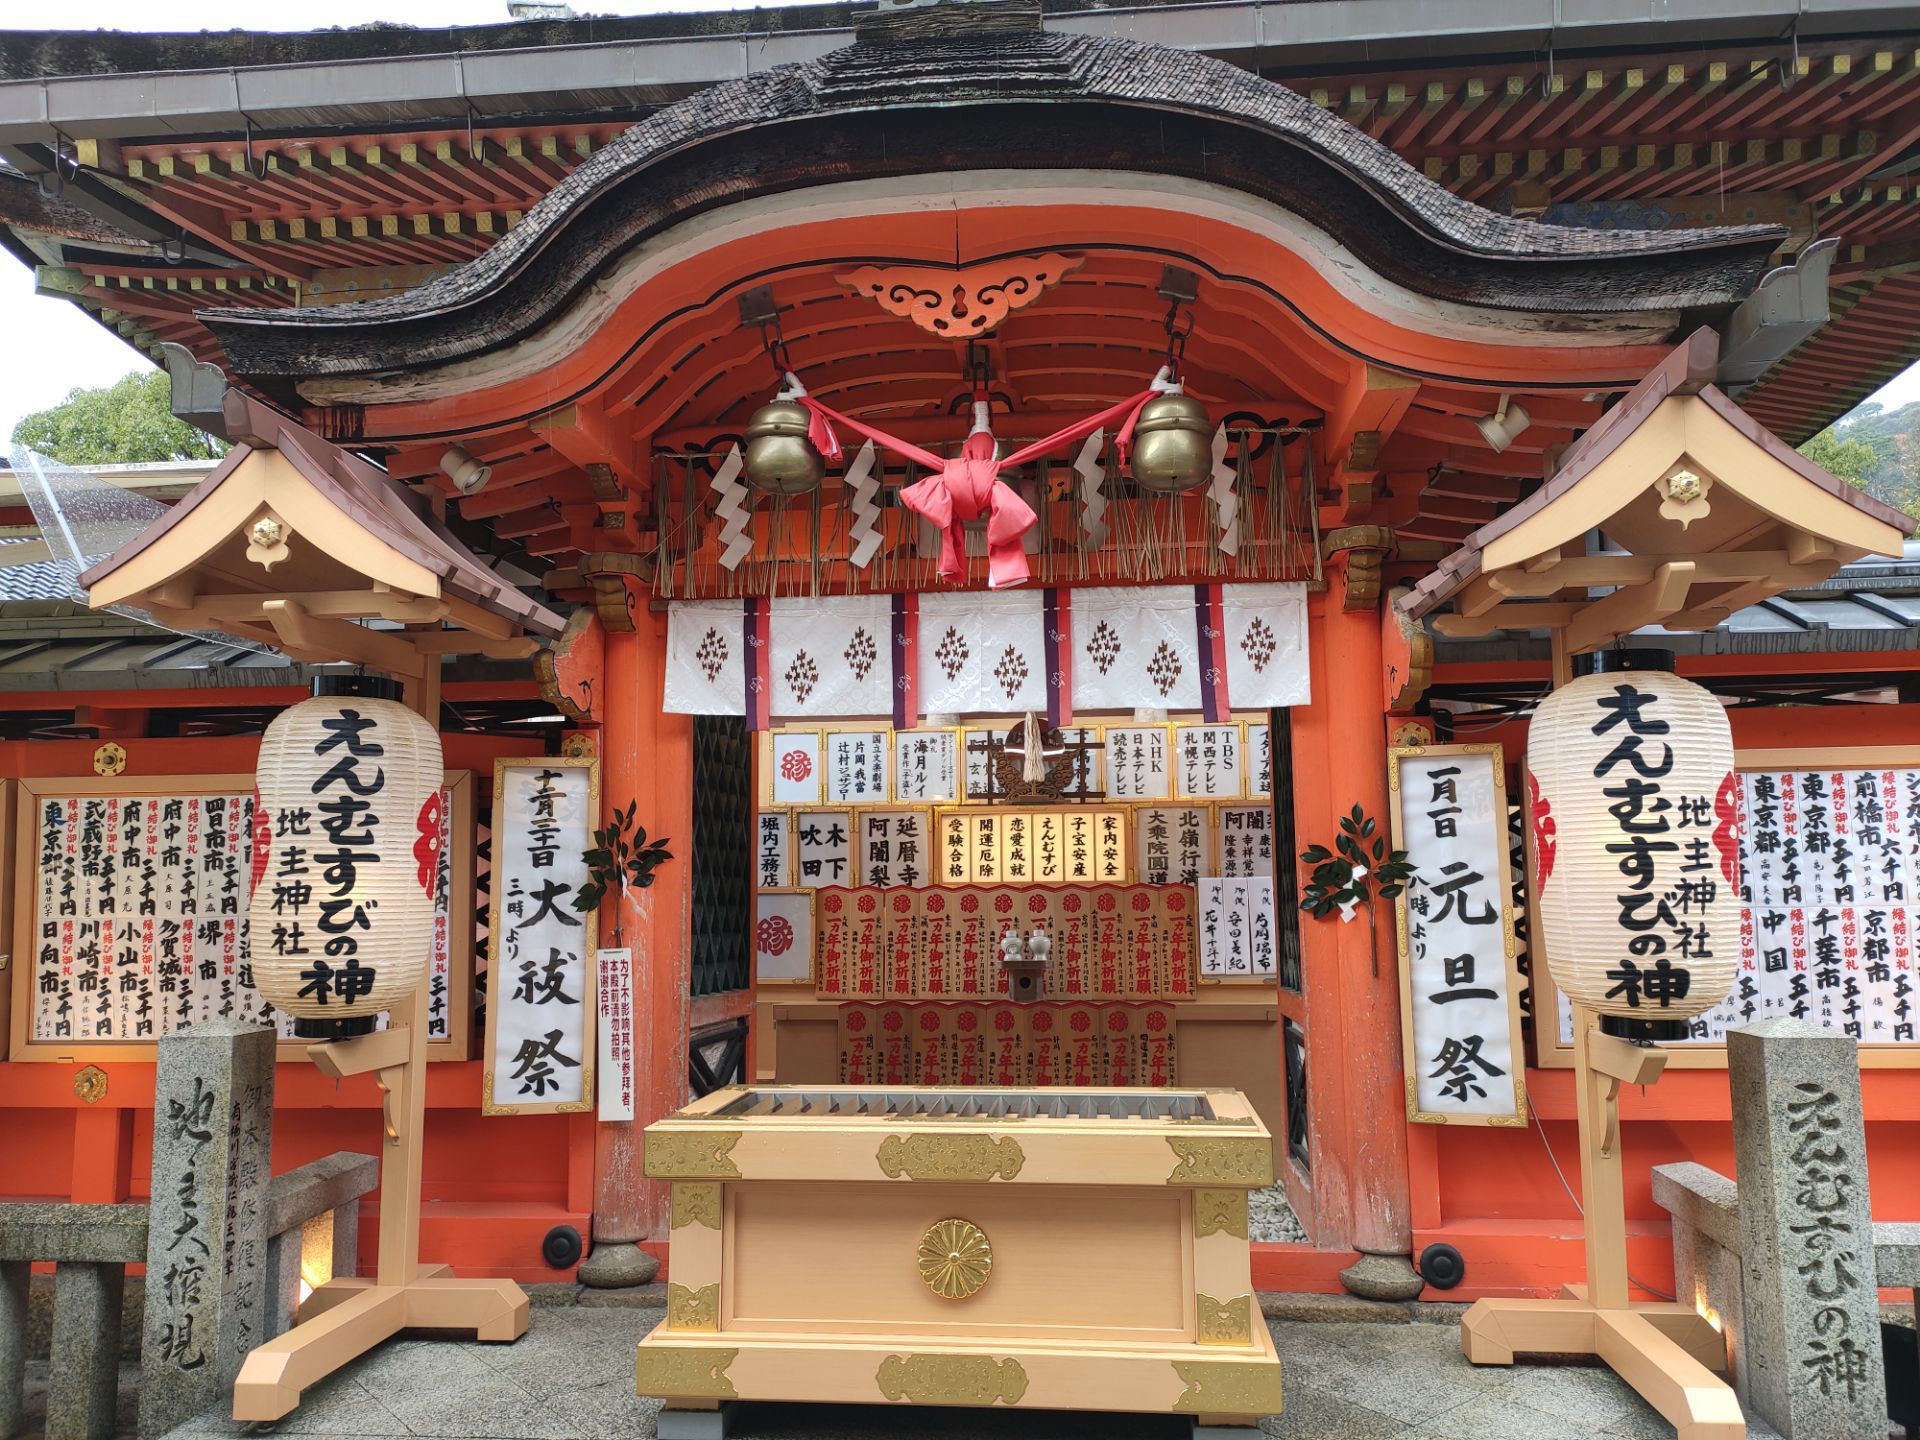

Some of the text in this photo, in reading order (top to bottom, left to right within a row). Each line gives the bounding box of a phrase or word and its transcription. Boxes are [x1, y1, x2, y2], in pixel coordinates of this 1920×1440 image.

[838, 741, 852, 800] 辻村ジュサブロー
[854, 741, 867, 793] 片岡我當
[872, 734, 883, 793] 国立文楽劇場
[914, 739, 928, 798] 海月ルイ
[1113, 733, 1127, 795] 読売テレビ
[1132, 733, 1145, 794] 日本テレビ
[1151, 733, 1163, 772] NHK
[1184, 732, 1198, 793] 札幌テレビ
[1203, 732, 1216, 793] 関西テレビ
[1222, 731, 1234, 770] TBS
[67, 799, 78, 854] 縁結び御礼
[107, 799, 118, 854] 縁結び御礼
[146, 800, 158, 856] 縁結び御礼
[162, 799, 184, 868] 府中市
[187, 800, 199, 855] 縁結び御礼
[228, 798, 240, 854] 縁結び御礼
[1426, 767, 1463, 839] 一月一日
[1753, 775, 1783, 855] 東京都
[1780, 774, 1797, 836] 縁結び御礼
[1803, 773, 1832, 854] 東京都
[1831, 773, 1849, 835] 縁結び御礼
[1853, 772, 1884, 847] 前橋市
[1881, 771, 1900, 834] 縁結び御礼
[81, 799, 108, 877] 武蔵野市
[122, 801, 145, 868] 府中市
[203, 798, 226, 873] 四日市市
[296, 709, 384, 1005] えんむすびの神
[761, 817, 780, 887] 堀内工務店
[897, 816, 919, 887] 延暦寺
[948, 818, 964, 878] 受験合格
[978, 819, 995, 878] 開運厄除
[1009, 817, 1026, 877] 恋愛成就
[1040, 817, 1056, 876] えんむすび
[1071, 817, 1088, 877] 子宝安産
[1101, 816, 1118, 877] 家内安全
[1591, 684, 1690, 1008] えんむすびの神
[138, 858, 157, 916] 三千円
[180, 858, 198, 916] 三千円
[221, 856, 238, 916] 三千円
[271, 807, 312, 957] 地主神社
[1671, 794, 1716, 959] 地主神社
[1782, 839, 1802, 905] 五千円
[1832, 839, 1855, 904] 五千円
[1879, 838, 1903, 902] 六千円
[62, 919, 73, 976] 縁結び御礼
[103, 919, 113, 976] 縁結び御礼
[142, 919, 153, 976] 縁結び御礼
[183, 919, 193, 976] 縁結び御礼
[224, 919, 235, 976] 縁結び御礼
[505, 878, 525, 962] 三時より
[1408, 875, 1431, 962] 八時より
[1739, 908, 1756, 971] 縁結び御礼
[1762, 909, 1788, 974] 中国
[1790, 907, 1807, 971] 縁結び御礼
[1812, 907, 1842, 990] 千葉市
[1841, 907, 1859, 971] 縁結び御礼
[1862, 909, 1890, 983] 京都市
[1891, 907, 1910, 971] 縁結び御礼
[39, 921, 60, 994] 日向市
[77, 920, 101, 993] 川崎市
[115, 921, 142, 994] 小山市
[158, 920, 182, 994] 多賀城市
[198, 920, 223, 981] 堺市
[56, 979, 74, 1037] 三千円
[96, 977, 113, 1037] 三千円
[135, 979, 153, 1037] 三千円
[428, 975, 447, 1036] 三千円
[509, 878, 583, 1098] 大祓祭
[600, 959, 610, 1019] 谢谢合作
[1428, 861, 1507, 1104] 元旦祭
[1841, 976, 1862, 1040] 五千円
[1892, 974, 1914, 1042] 五千円
[1787, 1083, 1866, 1404] えんむすびの神
